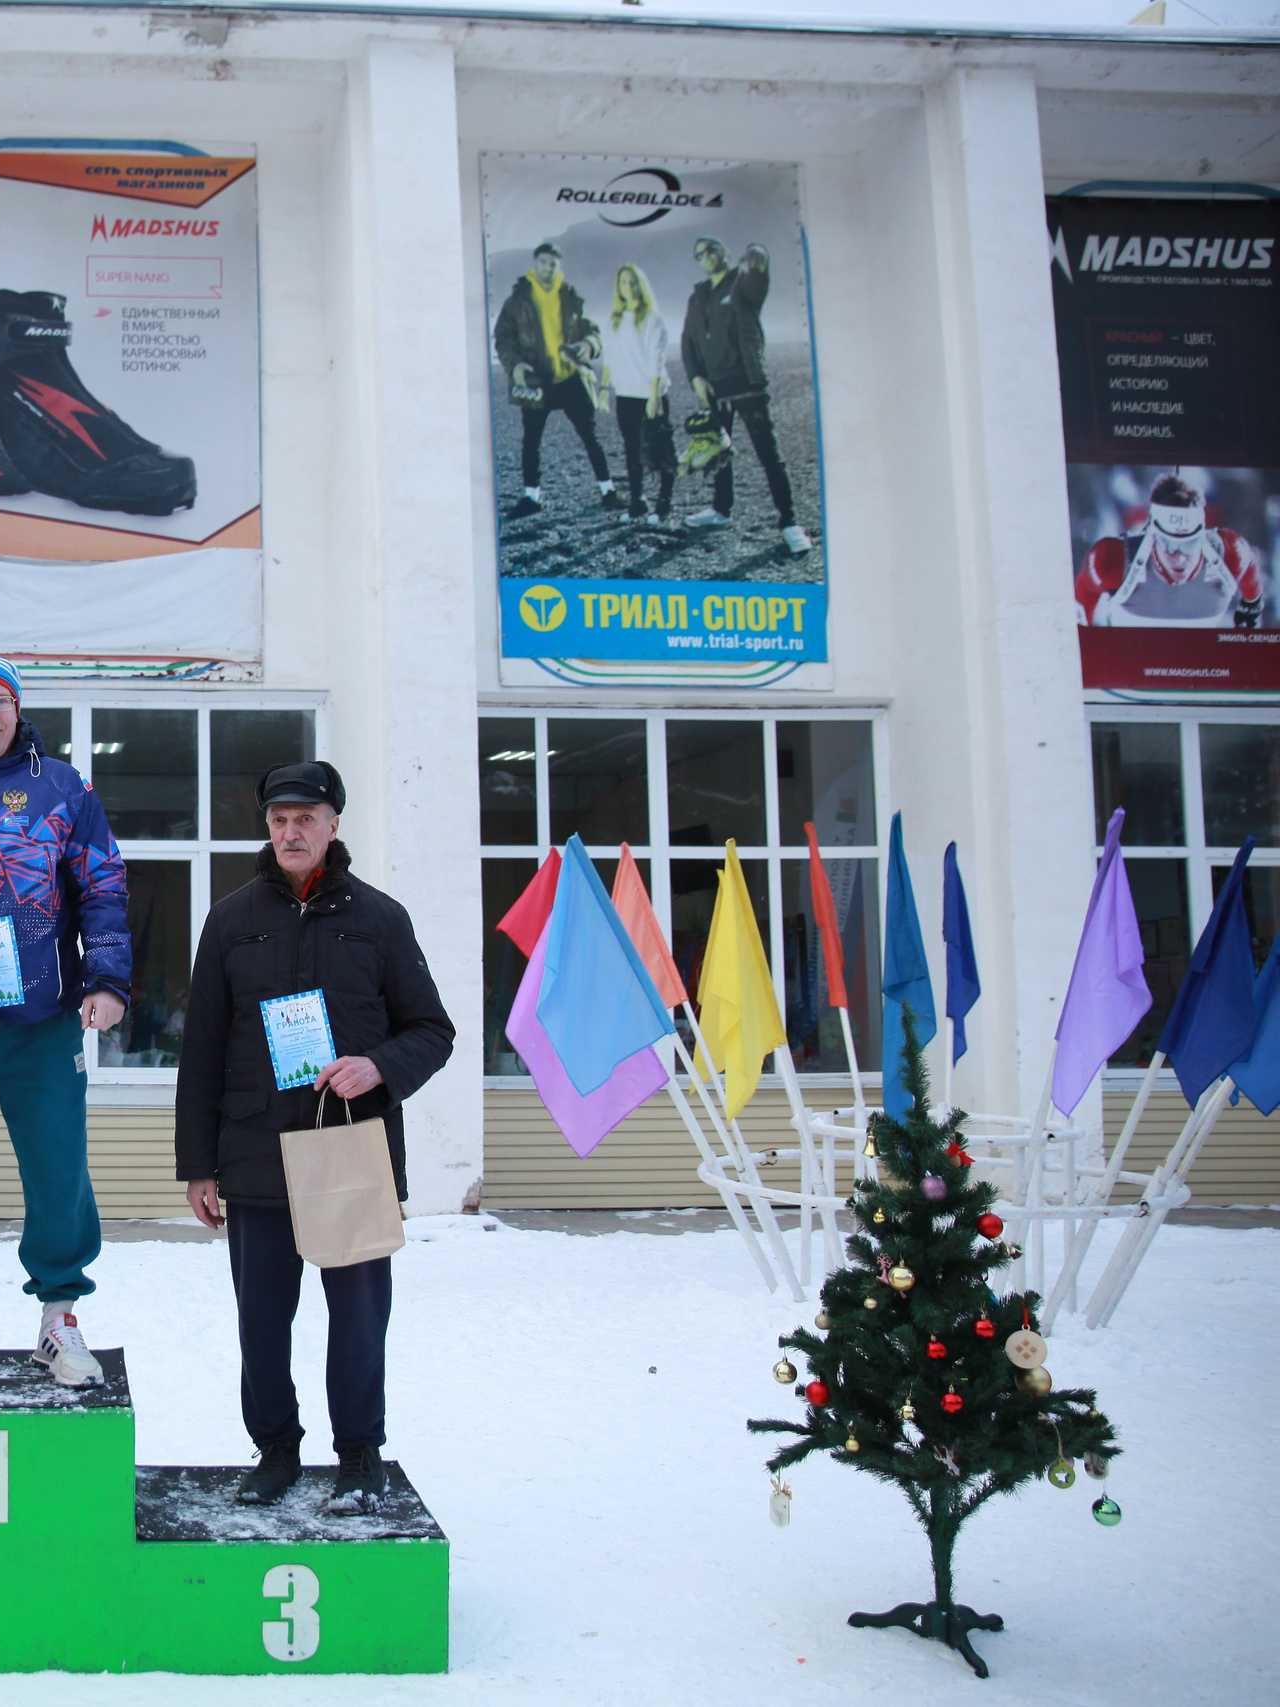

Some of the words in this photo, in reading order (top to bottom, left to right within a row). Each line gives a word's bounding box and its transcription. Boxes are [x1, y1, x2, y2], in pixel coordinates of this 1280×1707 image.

[85, 165, 121, 176] сеть
[125, 166, 228, 179] спортивных
[117, 179, 206, 190] магазинов
[110, 218, 220, 238] MADSHUS
[1078, 234, 1275, 273] MADSHUS
[95, 272, 132, 283] SUPER
[134, 272, 170, 284] NANO
[121, 307, 221, 320] ЕДИНСТВЕННЫЙ
[122, 322, 130, 332] В
[132, 322, 166, 332] МИРЕ
[121, 335, 201, 346] ПОЛНОСТЬЮ
[121, 347, 207, 359] КАРБОНОВЫЙ
[121, 361, 181, 373] БОТИНОК
[1106, 353, 1209, 369] ОПРЕДЕЛЯЮЩИЙ
[1109, 377, 1169, 391] ИСТОРИЮ
[1111, 401, 1121, 413] И
[1123, 401, 1185, 415] НАСЛЕДИЕ
[666, 634, 804, 652] www.trial-sport.ru
[276, 1015, 317, 1030] ГРАМОТА
[262, 1563, 322, 1663] 3
